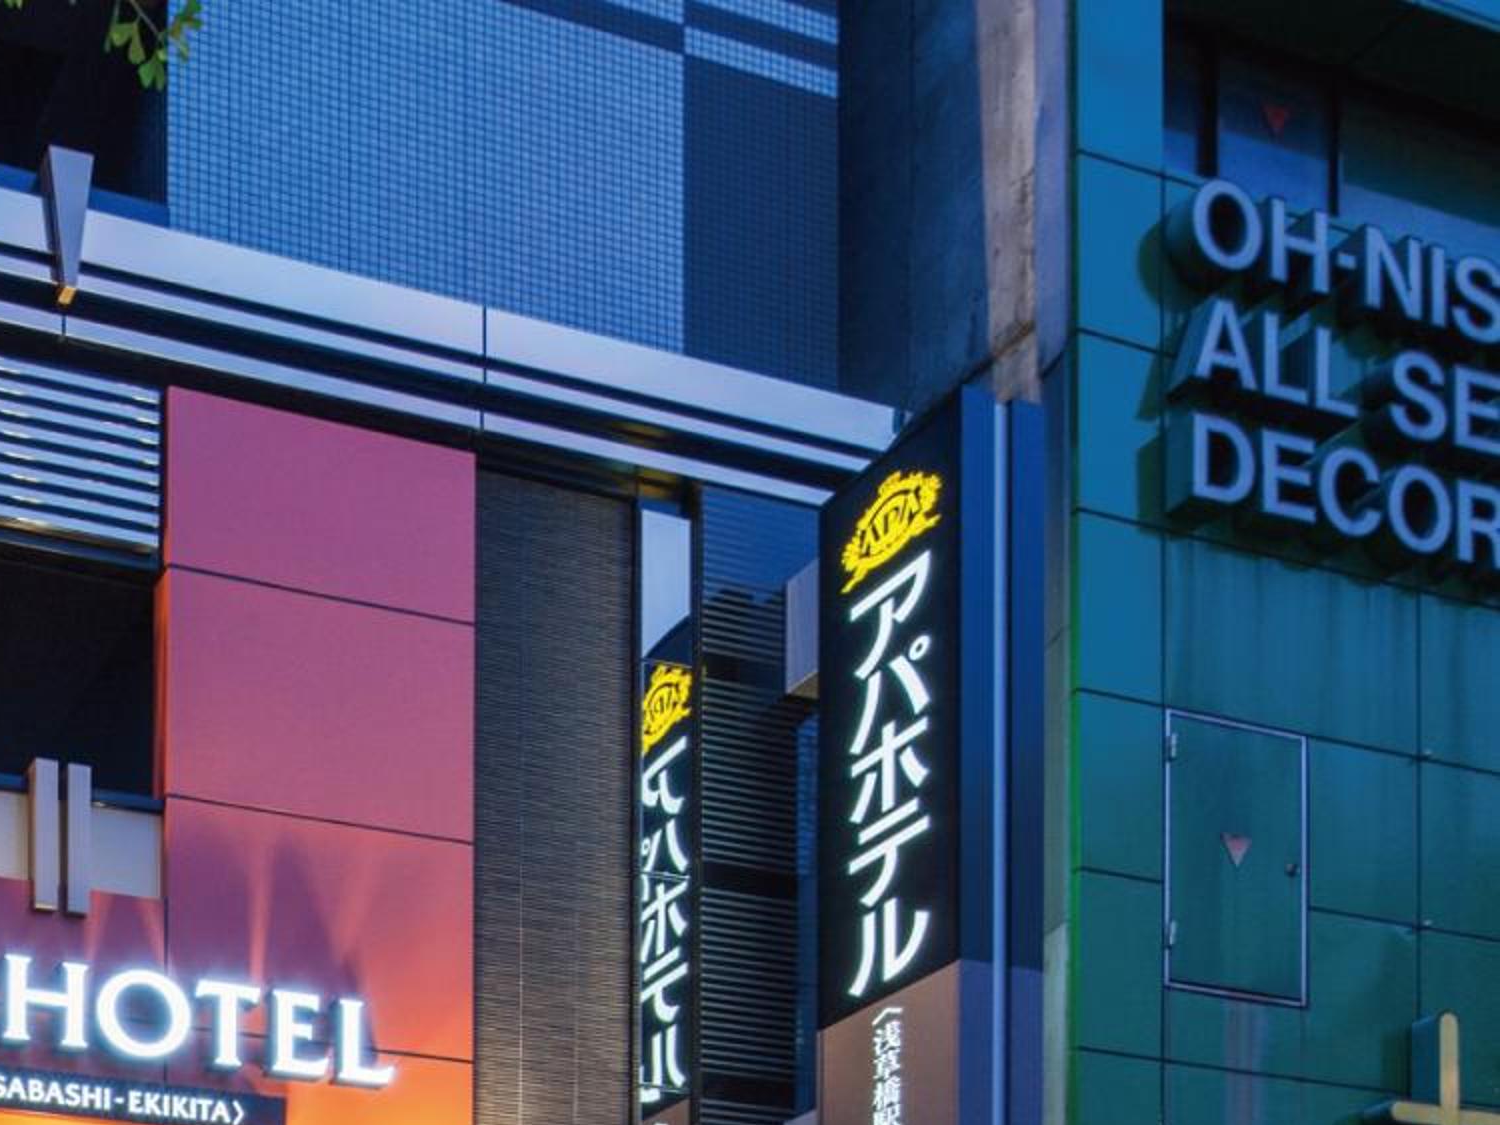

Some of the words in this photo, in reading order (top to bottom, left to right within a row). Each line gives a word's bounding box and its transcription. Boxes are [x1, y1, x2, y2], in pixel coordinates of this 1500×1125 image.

[1193, 179, 1500, 344] OH-NIS
[1195, 299, 1359, 418] ALL
[1390, 350, 1500, 457] SE
[1192, 412, 1500, 570] DECOR
[849, 548, 931, 998] アパホテル
[1, 952, 397, 1087] HOTEL
